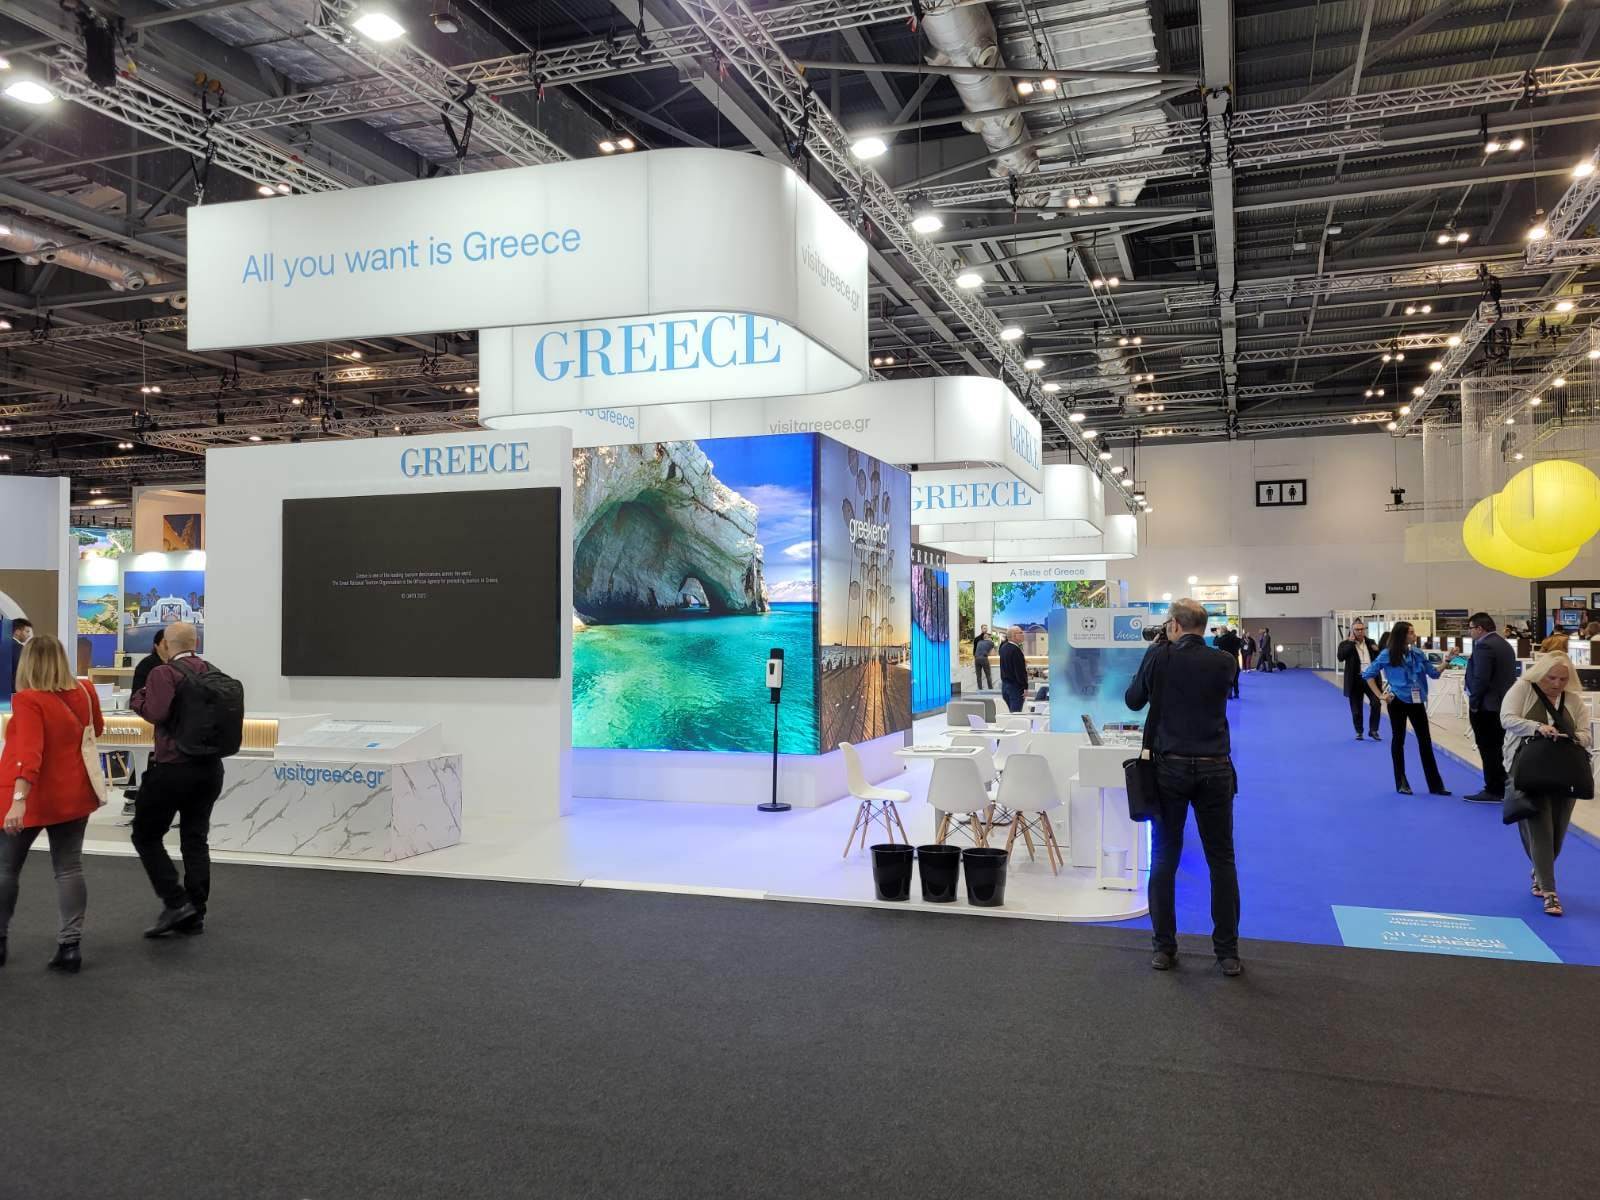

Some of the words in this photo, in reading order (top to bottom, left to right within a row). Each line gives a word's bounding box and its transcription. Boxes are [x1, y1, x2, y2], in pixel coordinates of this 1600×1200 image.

[242, 252, 274, 284] All
[283, 252, 335, 287] you
[344, 239, 419, 273] want
[429, 235, 453, 265] is
[462, 227, 582, 263] Greece
[801, 243, 861, 312] visitgreece.gr
[533, 312, 781, 383] GREECE
[400, 442, 530, 478] GREECE
[911, 480, 1032, 511] GREECE
[1010, 568, 1017, 577] A
[1018, 567, 1041, 577] Taste
[1043, 567, 1052, 577] of
[1054, 566, 1085, 577] Greece
[273, 762, 385, 788] visitgreece.gr
